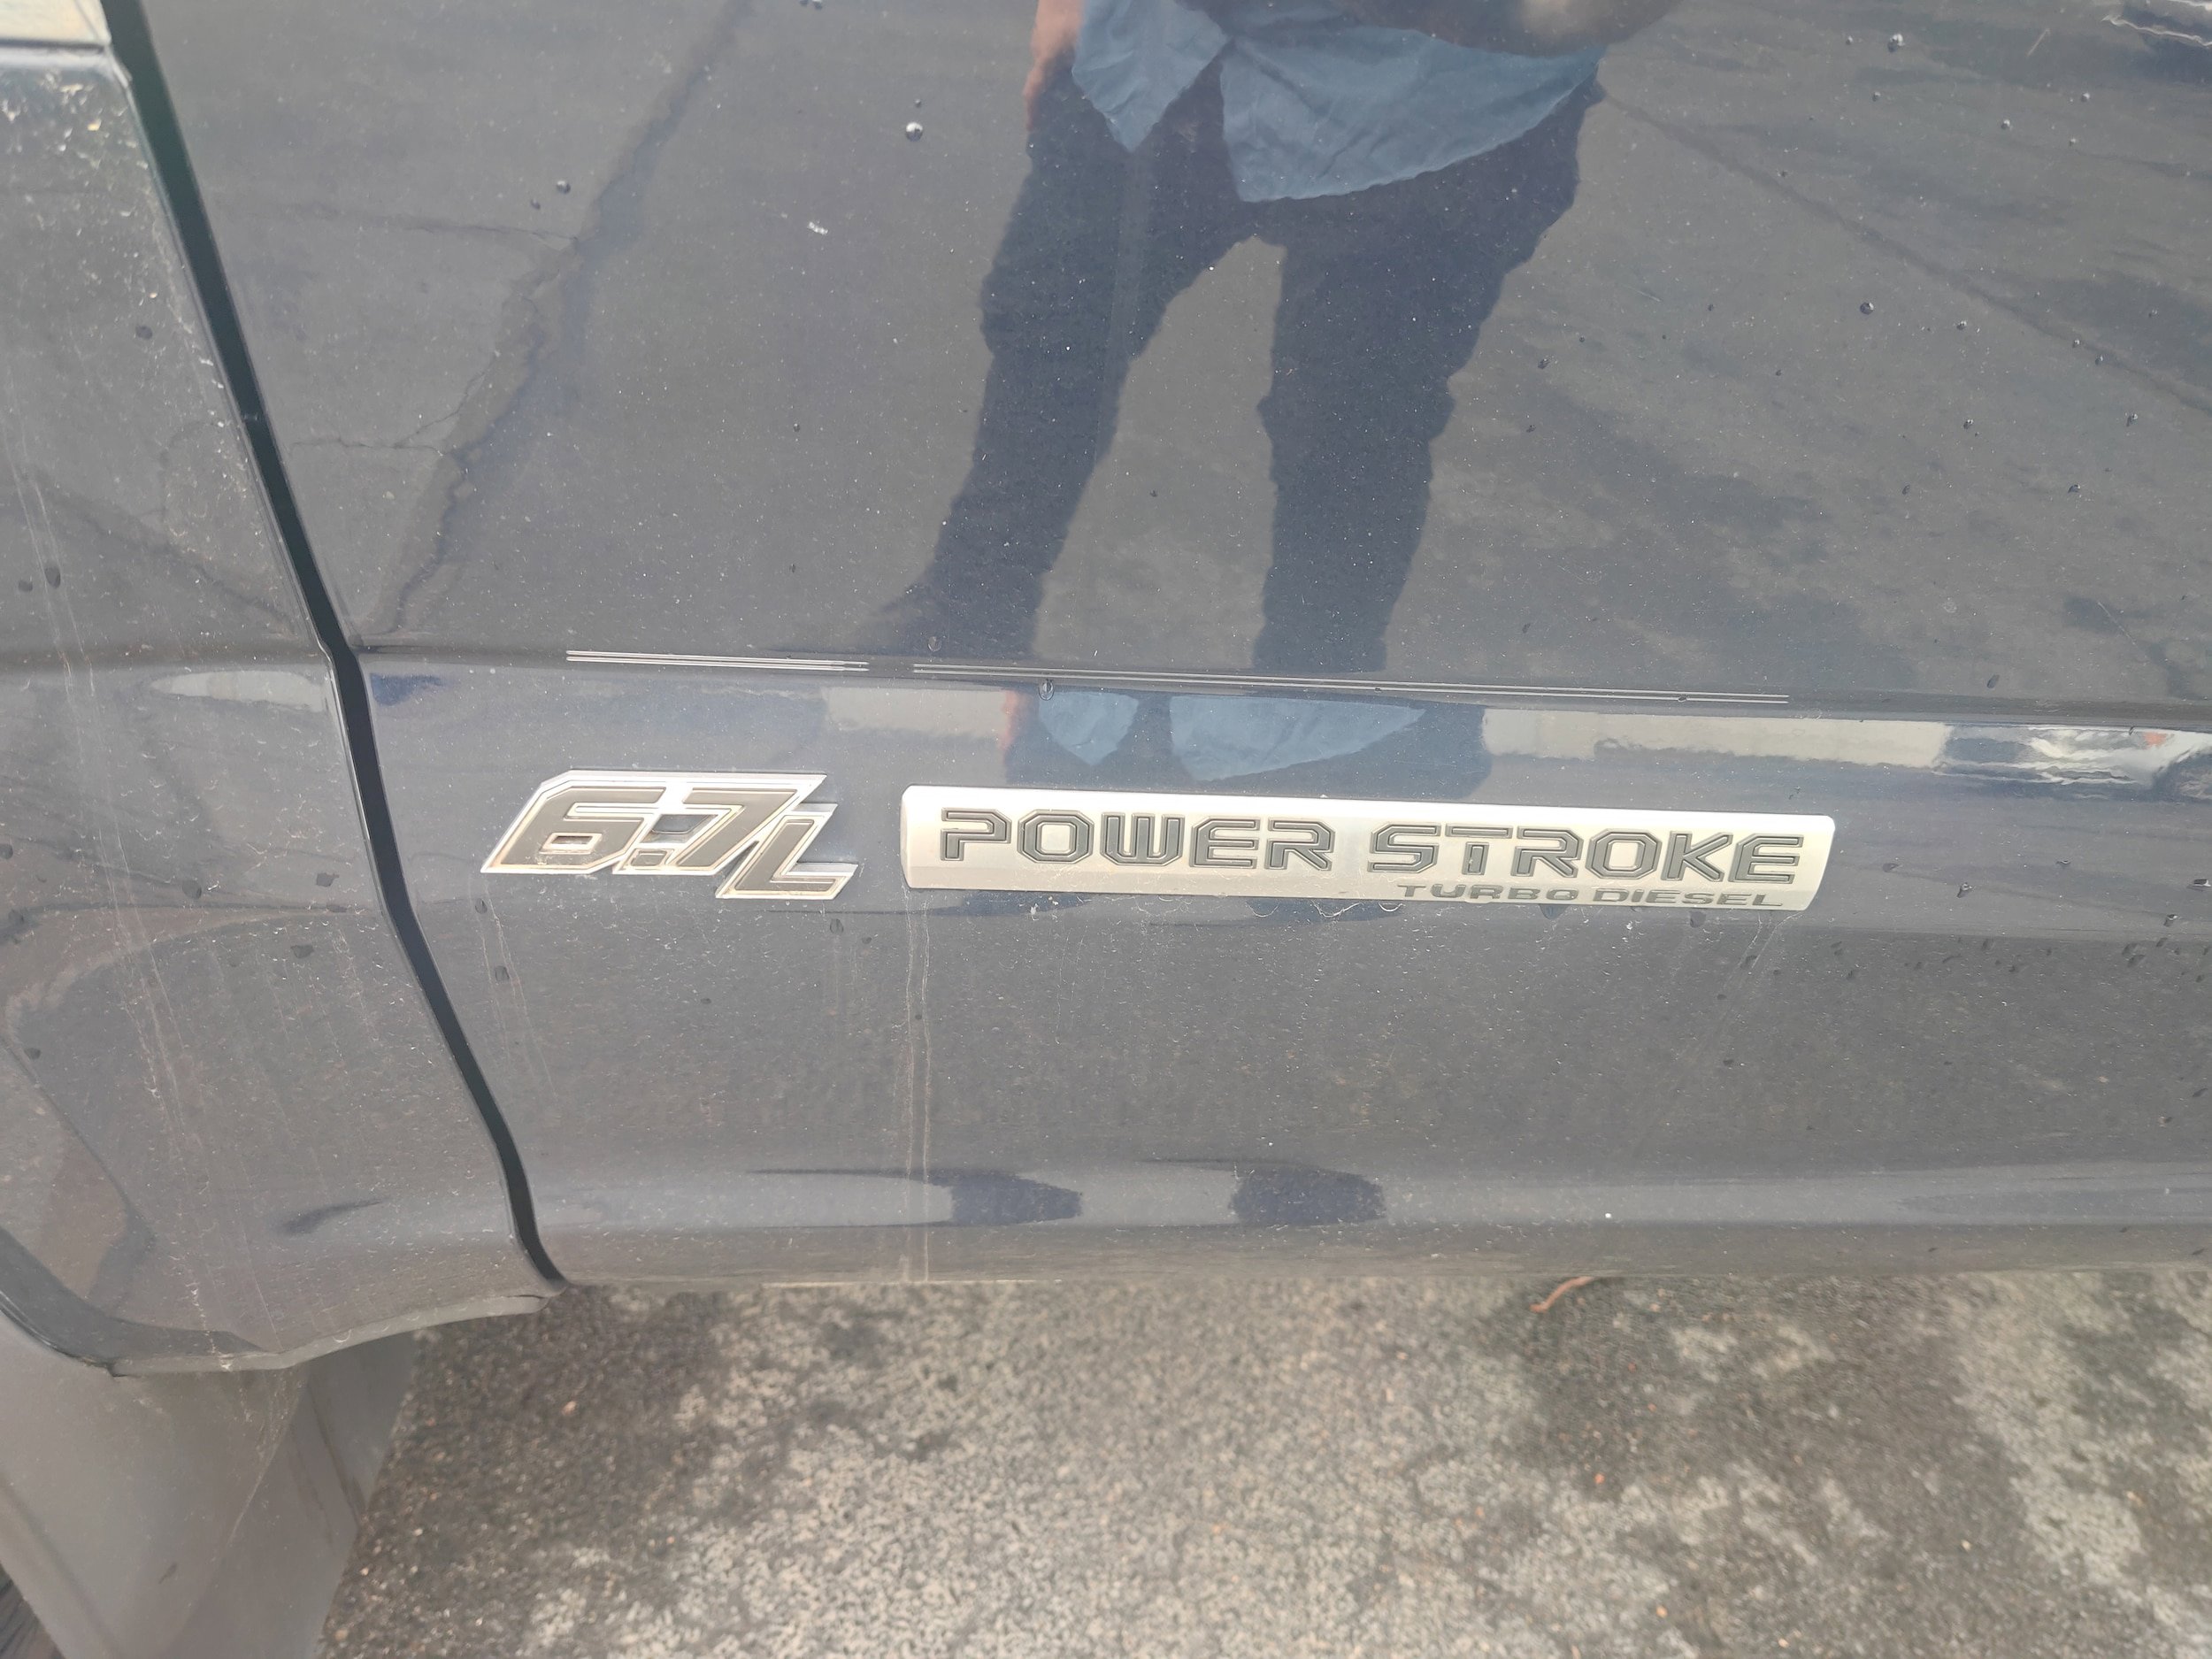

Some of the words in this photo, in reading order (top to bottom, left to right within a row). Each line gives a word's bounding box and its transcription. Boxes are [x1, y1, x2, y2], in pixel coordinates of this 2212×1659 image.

[480, 770, 858, 900] 6.7L
[941, 807, 1335, 872] POWER
[1367, 823, 1804, 884] STROKE
[1397, 884, 1580, 901] TURBO
[1592, 888, 1784, 907] DIESEL
